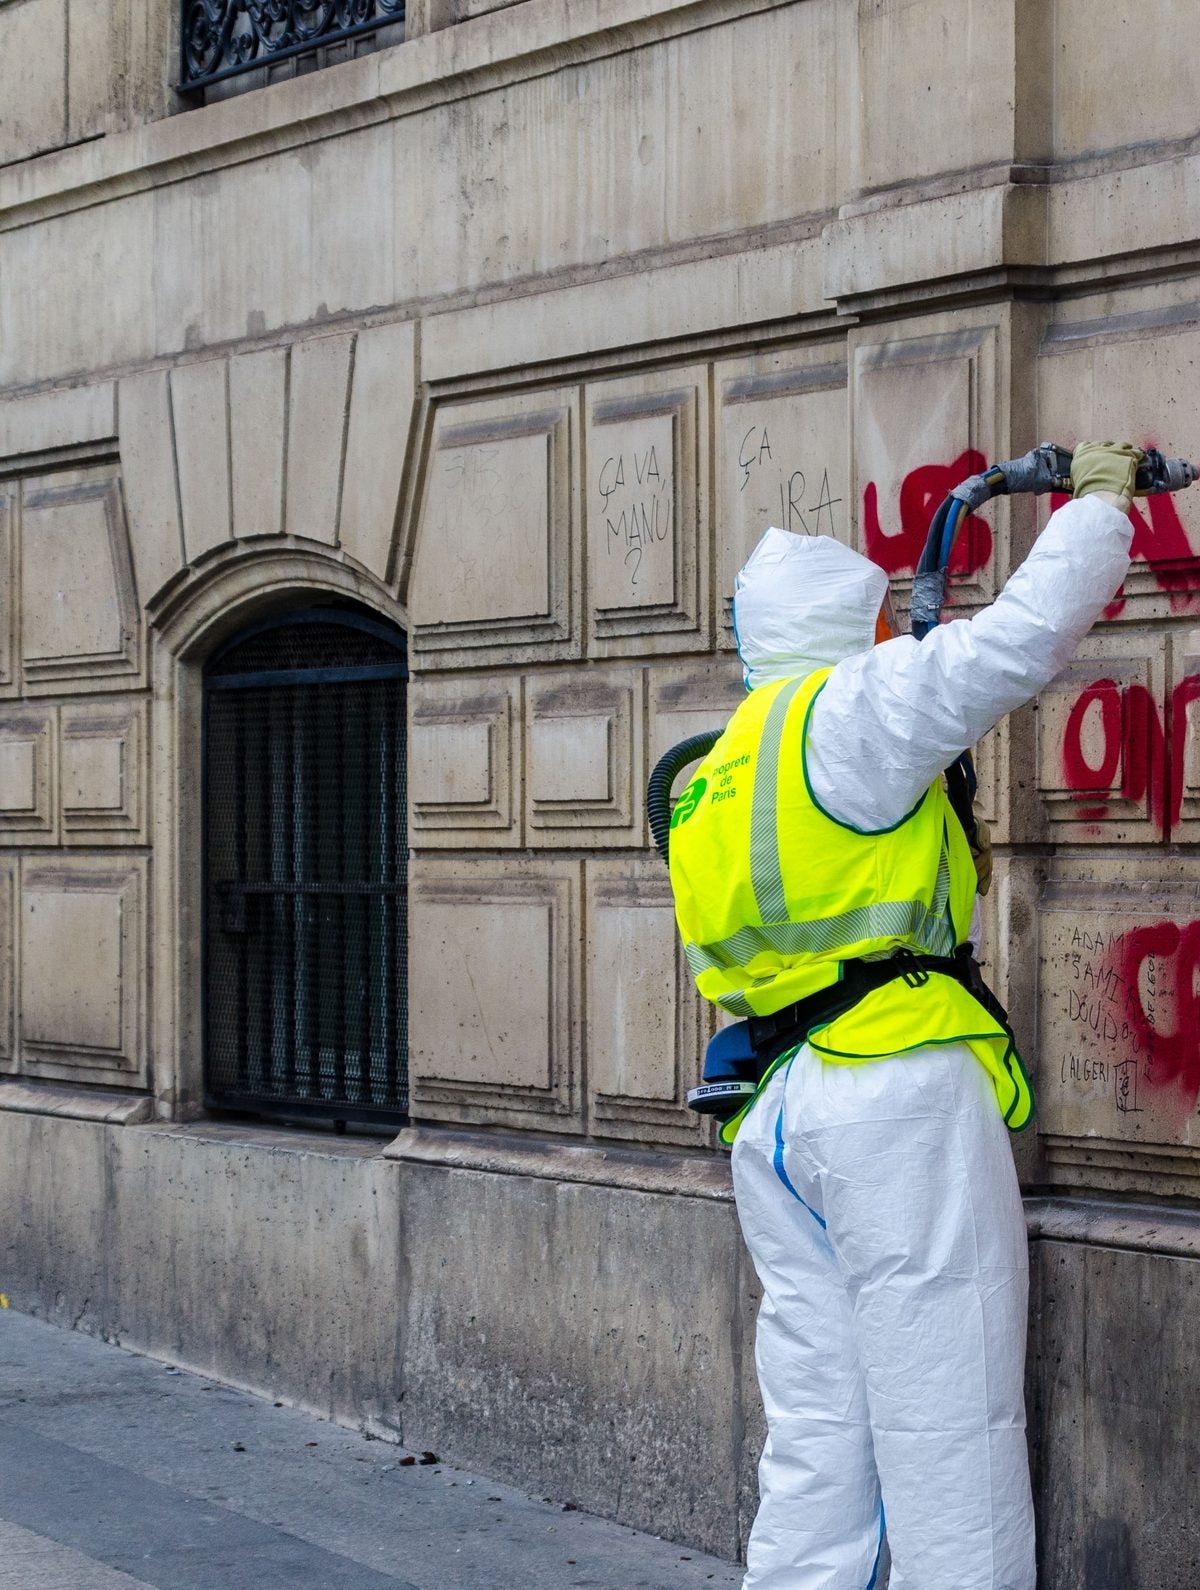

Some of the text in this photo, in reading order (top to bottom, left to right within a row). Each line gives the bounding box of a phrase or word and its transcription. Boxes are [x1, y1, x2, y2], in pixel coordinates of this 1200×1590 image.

[599, 455, 625, 513] ÇA
[739, 426, 772, 491] ÇA
[606, 494, 671, 555] MANU
[779, 467, 843, 538] IRA
[711, 787, 737, 805] Paris
[720, 774, 733, 788] de
[1071, 926, 1126, 966] ADAM
